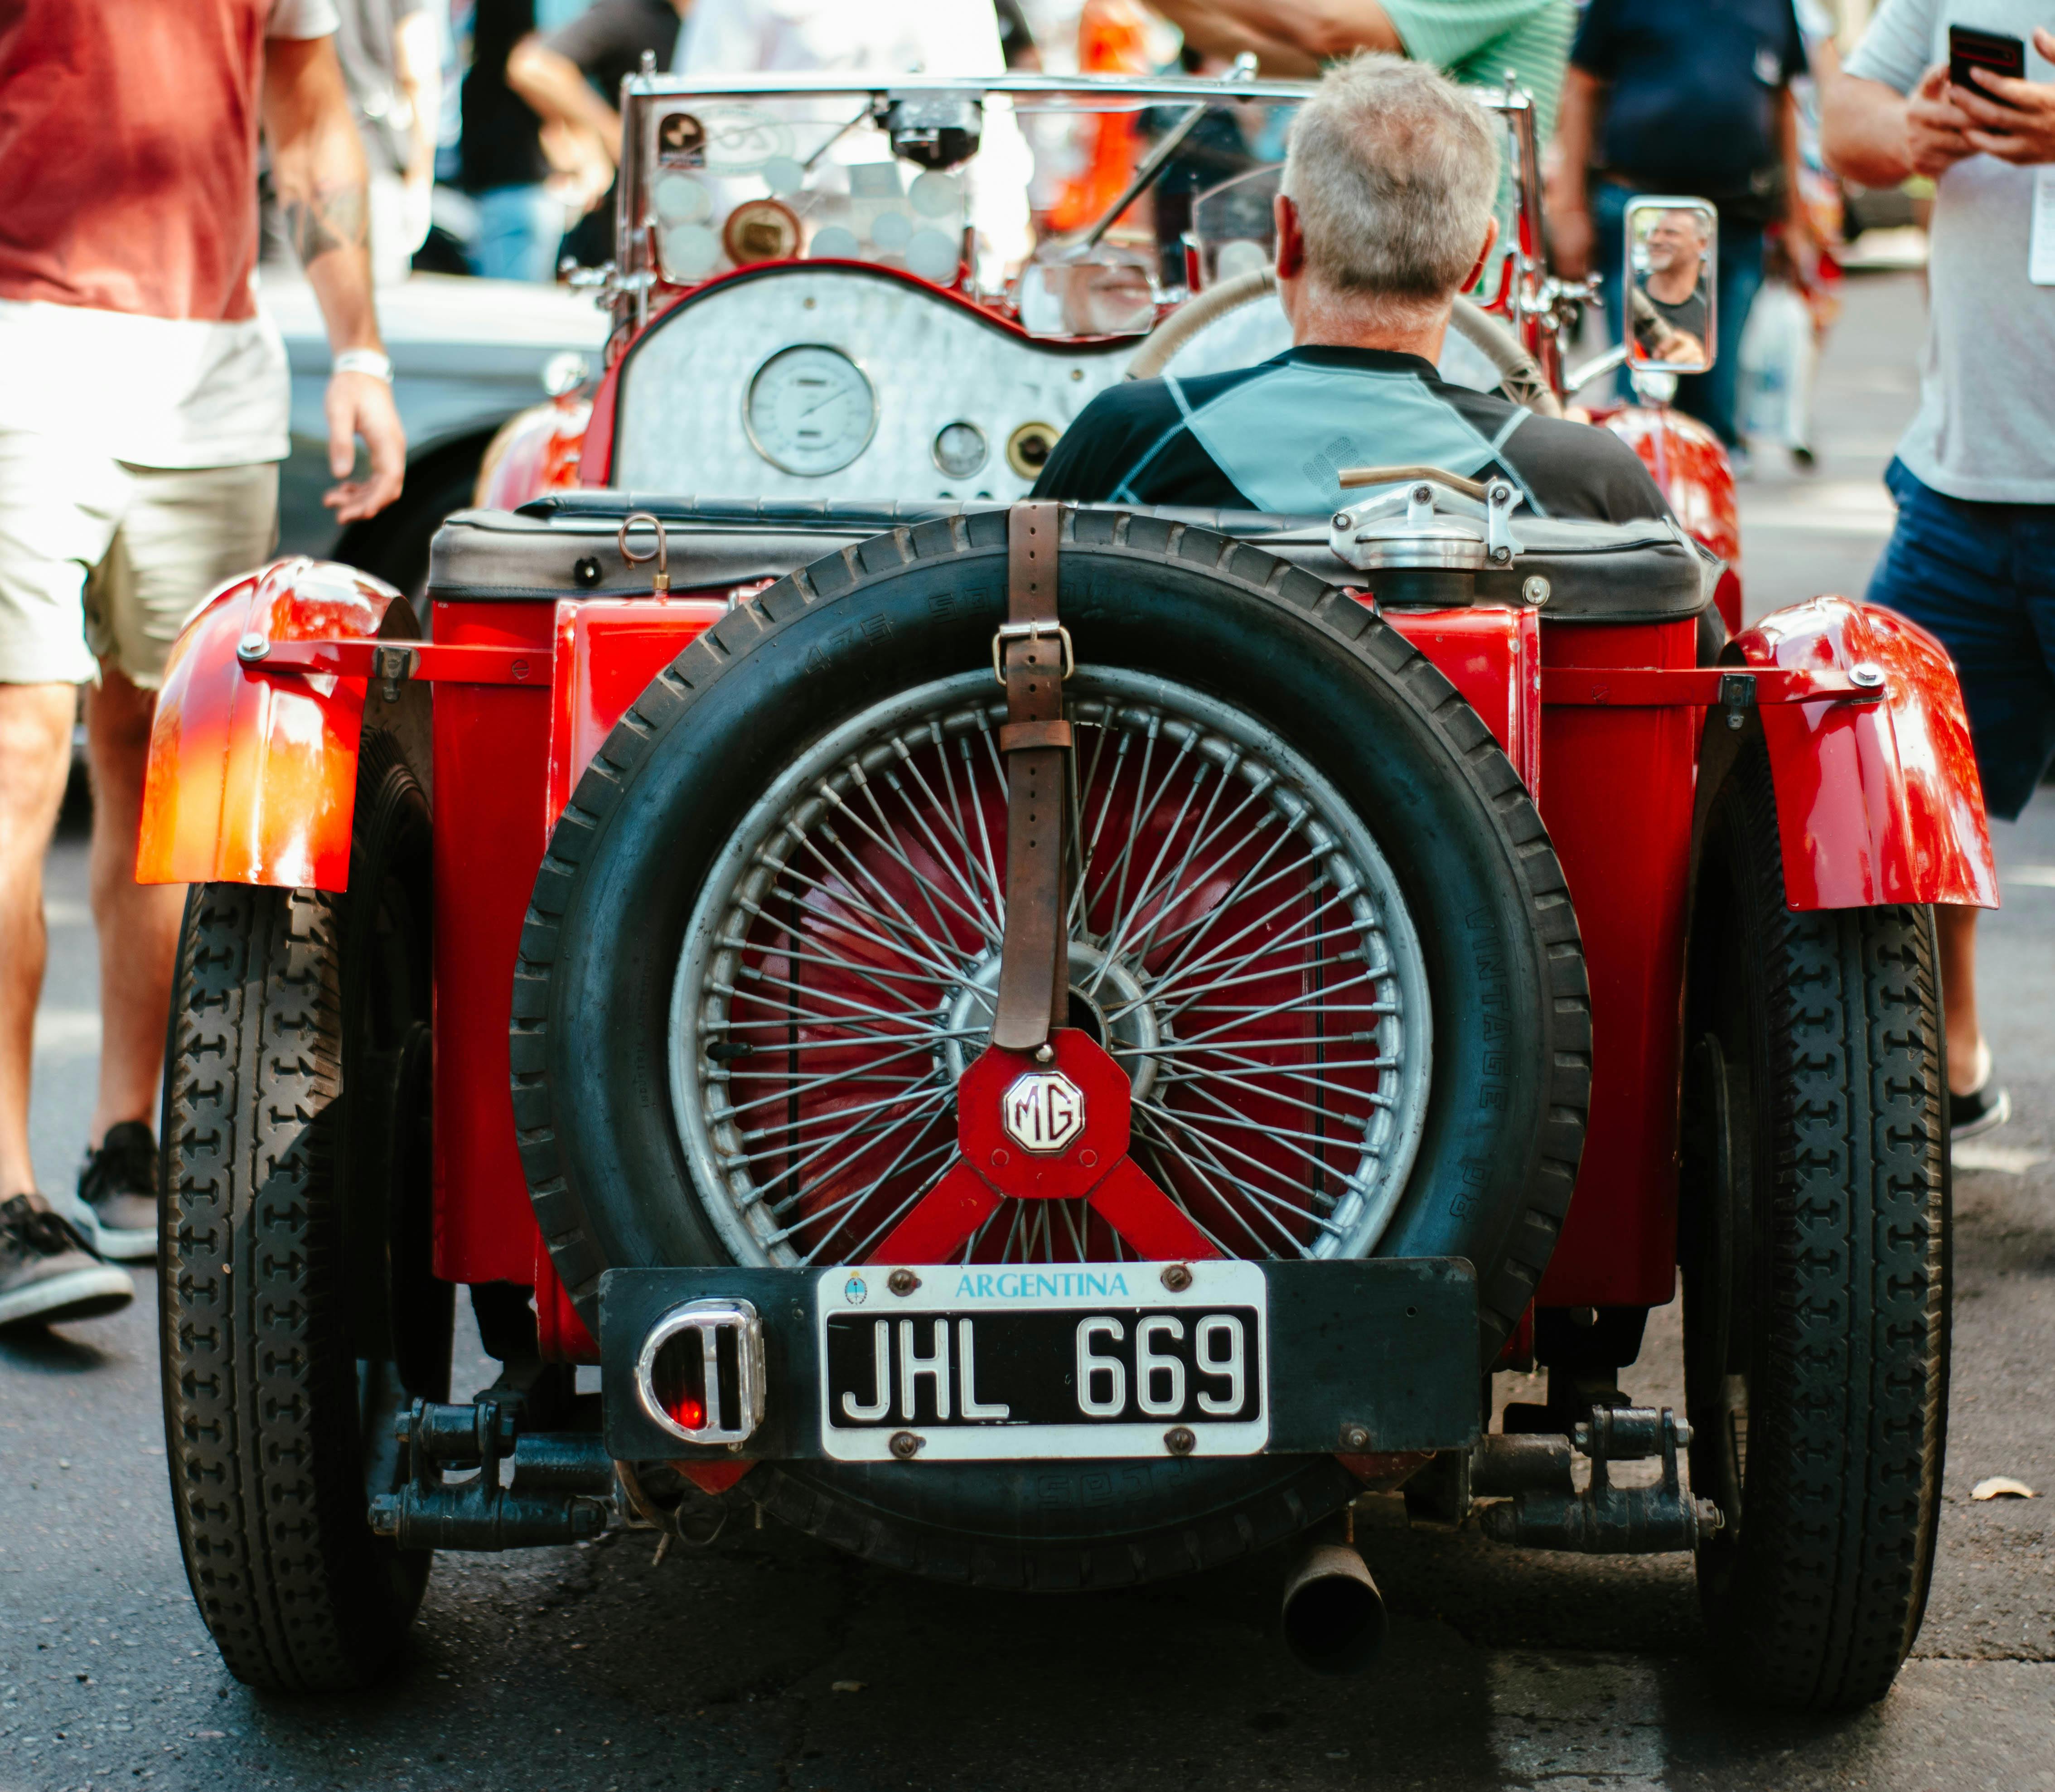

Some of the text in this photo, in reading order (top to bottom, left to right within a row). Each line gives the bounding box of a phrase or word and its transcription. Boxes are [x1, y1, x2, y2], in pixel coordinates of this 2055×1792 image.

[1465, 905, 1513, 1111] VINTAGE
[1015, 1083, 1073, 1142] MG
[955, 1272, 1129, 1299] ARGENTINA
[842, 1314, 1245, 1421] JHL 669
